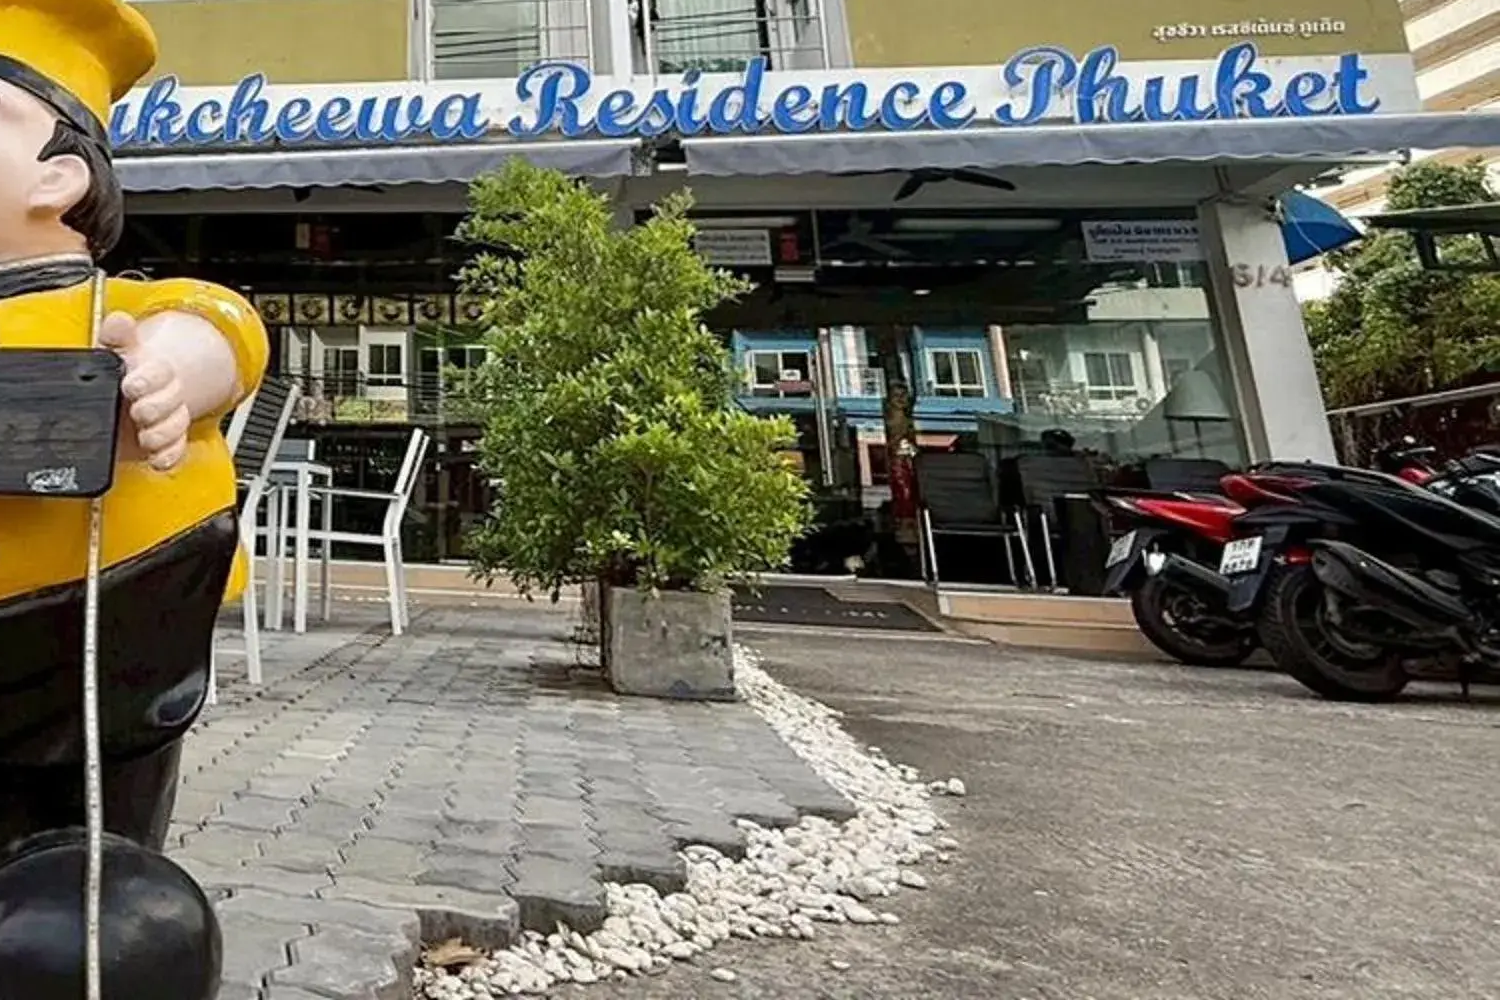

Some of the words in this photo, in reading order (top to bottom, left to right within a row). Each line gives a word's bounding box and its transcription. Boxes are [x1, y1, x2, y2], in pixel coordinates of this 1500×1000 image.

[110, 72, 490, 147] kcheewa
[506, 56, 978, 138] Residence
[995, 43, 1382, 126] Phuket
